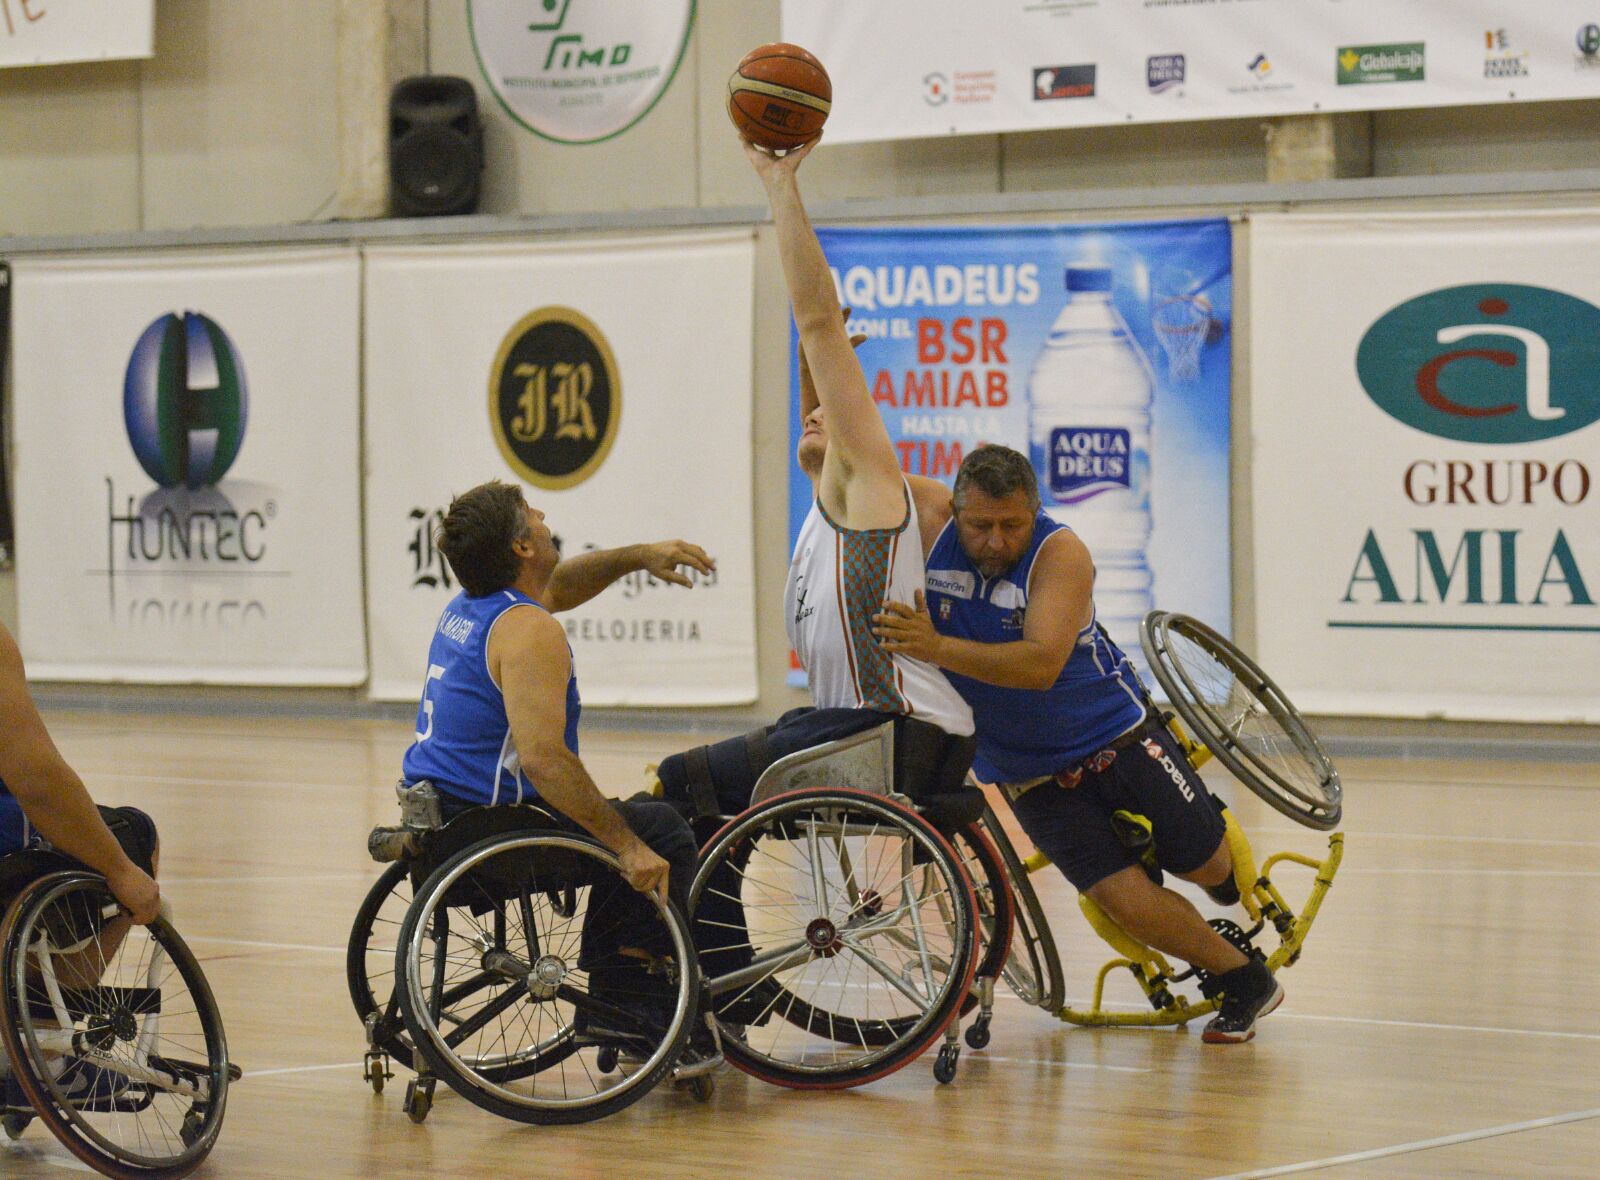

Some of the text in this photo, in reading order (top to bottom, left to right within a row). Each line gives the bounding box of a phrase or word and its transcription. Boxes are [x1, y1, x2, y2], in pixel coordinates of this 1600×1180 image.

[917, 317, 1009, 364] BSR
[872, 370, 1009, 409] AMIAB
[902, 416, 967, 436] HASTA
[1055, 432, 1127, 457] AQUA
[1058, 455, 1124, 477] DEUS
[1403, 459, 1591, 505] GRUPO
[565, 618, 702, 642] RELOJERIA
[415, 663, 446, 744] 5
